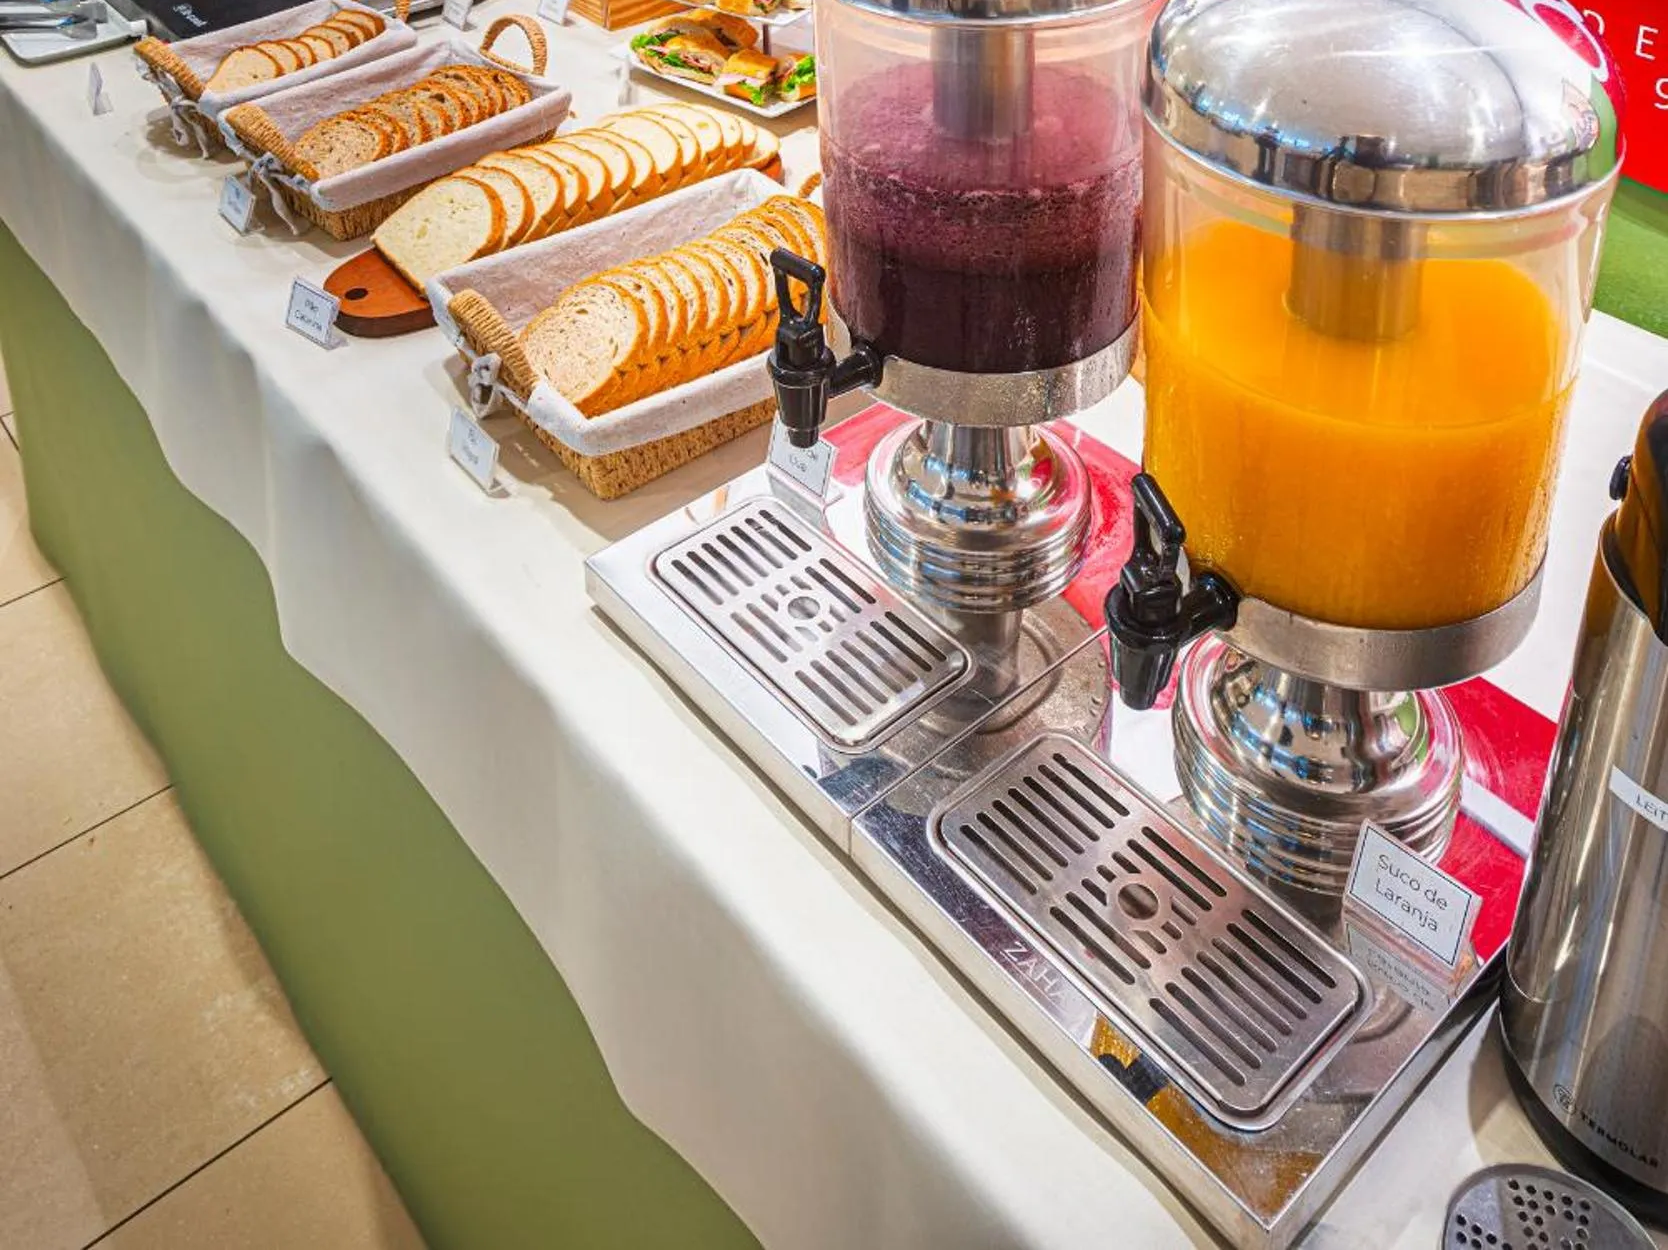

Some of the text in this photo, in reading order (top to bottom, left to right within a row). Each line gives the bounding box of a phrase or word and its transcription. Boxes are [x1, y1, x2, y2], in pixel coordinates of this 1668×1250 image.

[1375, 878, 1439, 933] Laranja
[1378, 853, 1449, 911] Suco de
